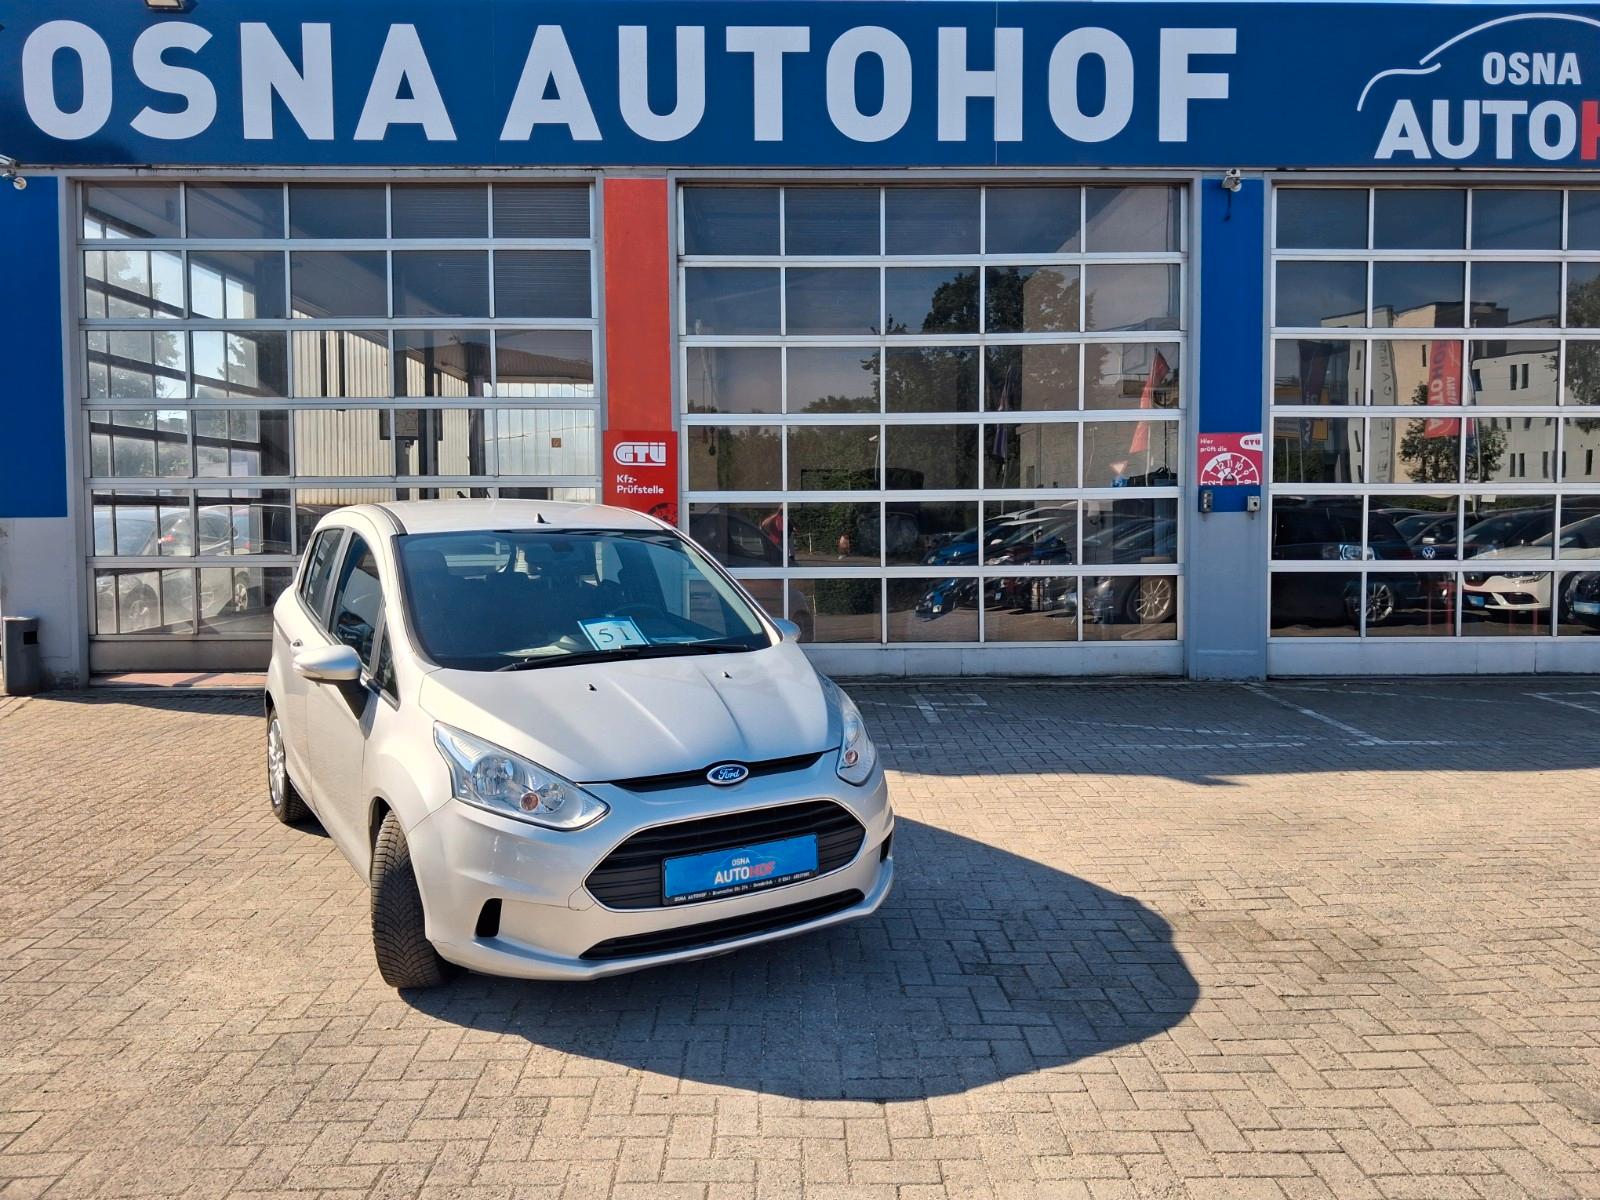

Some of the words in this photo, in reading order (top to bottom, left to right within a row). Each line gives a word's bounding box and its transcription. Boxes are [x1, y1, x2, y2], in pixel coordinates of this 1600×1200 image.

[1482, 51, 1582, 85] OSNA
[22, 19, 457, 141] OSNA
[499, 24, 1237, 142] AUTOHOF
[614, 442, 667, 466] GTÜ
[616, 474, 637, 483] Kfz-
[616, 485, 664, 494] Prüfstelle
[718, 767, 741, 780] Ford
[732, 857, 750, 867] OSNA
